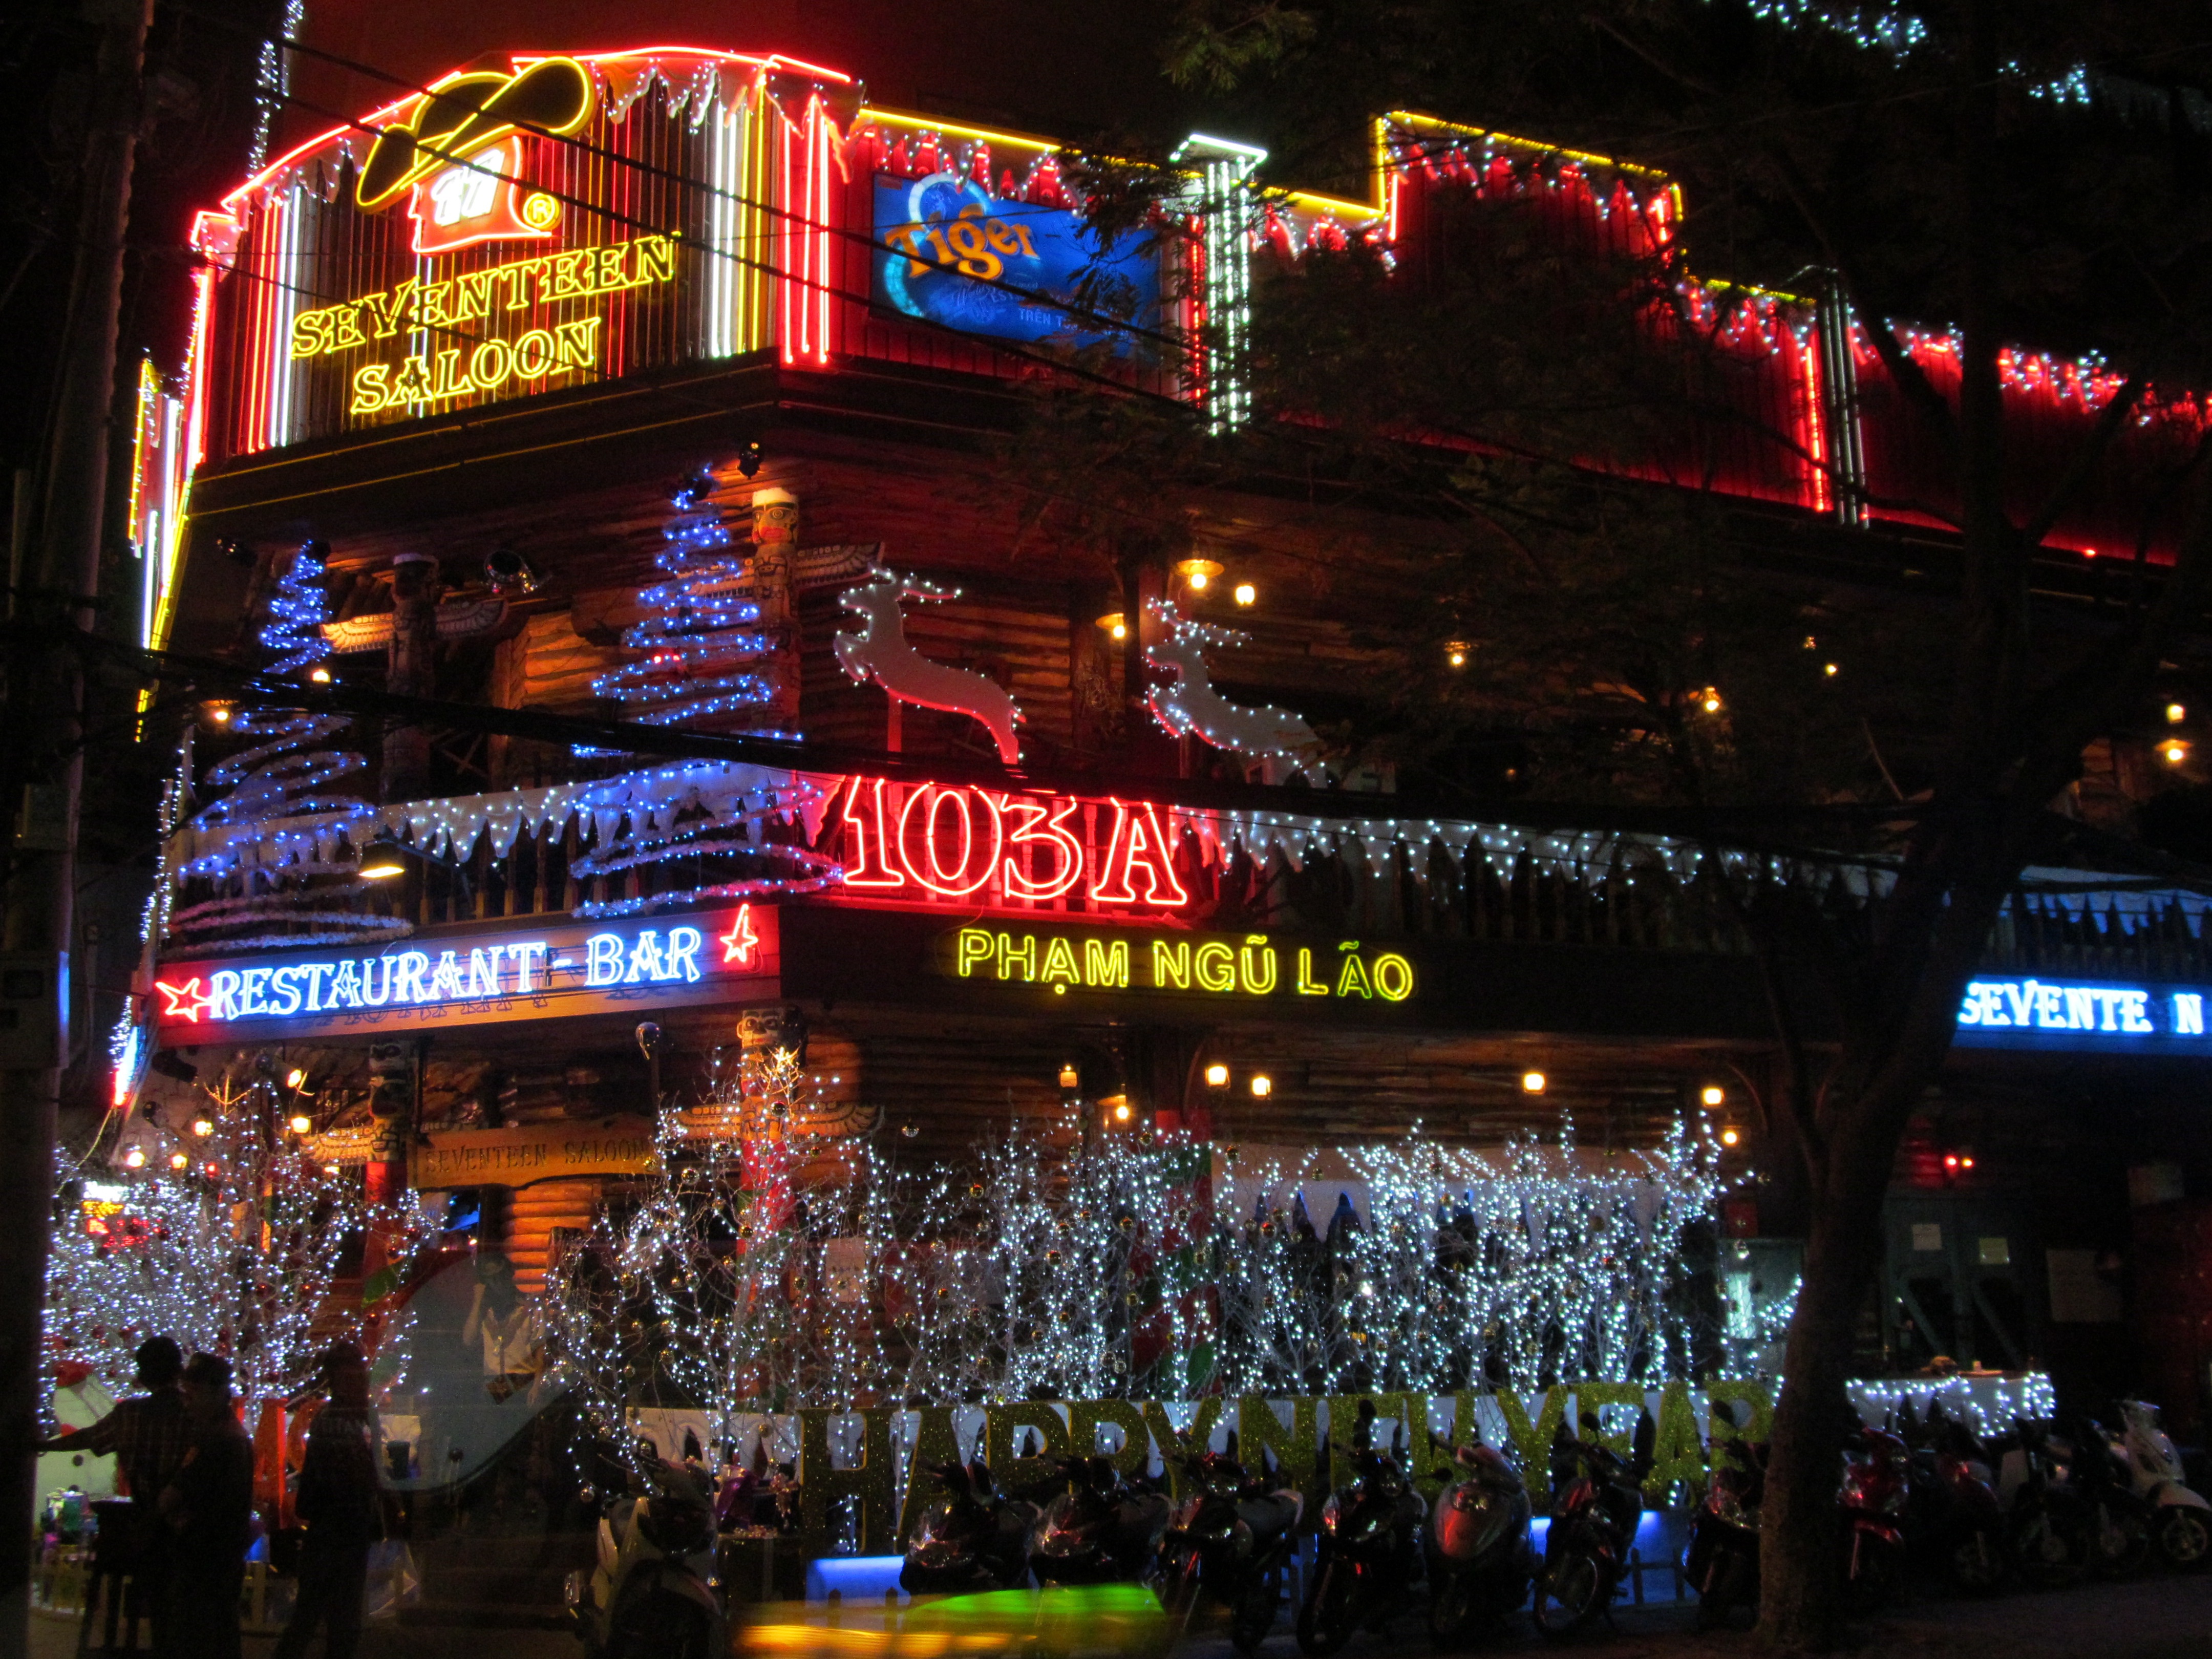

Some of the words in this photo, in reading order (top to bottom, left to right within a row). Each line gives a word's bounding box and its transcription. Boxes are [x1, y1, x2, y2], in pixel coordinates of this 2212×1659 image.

[884, 211, 1041, 281] Tiger
[291, 231, 682, 359] SEVENTEEN
[351, 316, 601, 414] SALOON
[843, 775, 1187, 905] 103A
[209, 941, 548, 1020] RESTAURANT
[584, 926, 702, 986] BAR
[1153, 934, 1277, 993] NGŨ
[1298, 941, 1413, 1001] LÃO
[425, 1143, 546, 1173] SEVENTEEN
[564, 1137, 646, 1164] SALOON
